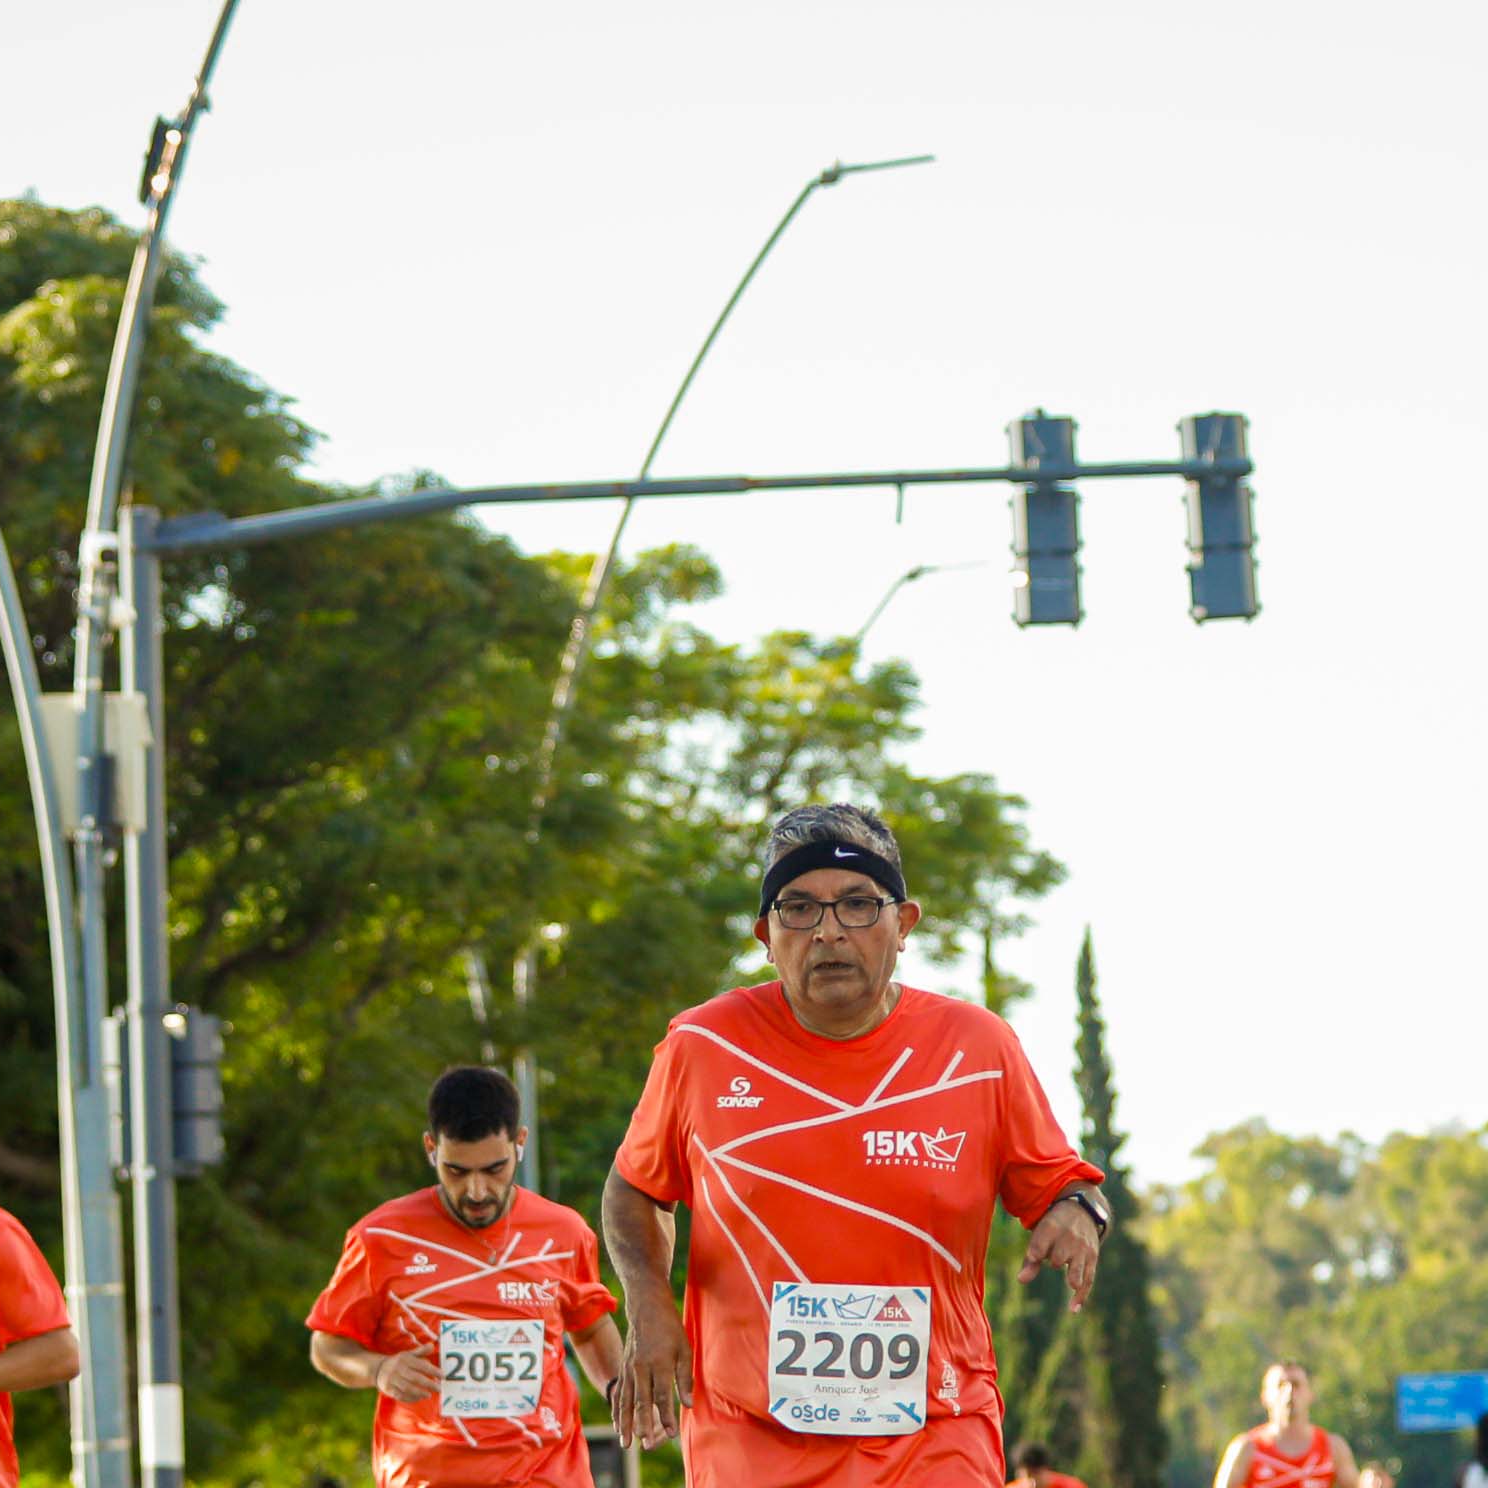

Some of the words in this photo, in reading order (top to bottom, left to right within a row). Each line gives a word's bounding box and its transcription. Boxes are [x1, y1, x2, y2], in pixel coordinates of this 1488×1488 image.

[862, 1130, 919, 1157] 15K
[866, 1158, 919, 1167] PUERTO
[496, 1282, 532, 1300] 15K
[787, 1294, 828, 1318] 15K
[883, 1306, 904, 1319] 15K
[451, 1330, 479, 1344] 15K
[775, 1329, 920, 1380] 2209
[445, 1351, 538, 1382] 2052
[790, 1404, 841, 1423] osde
